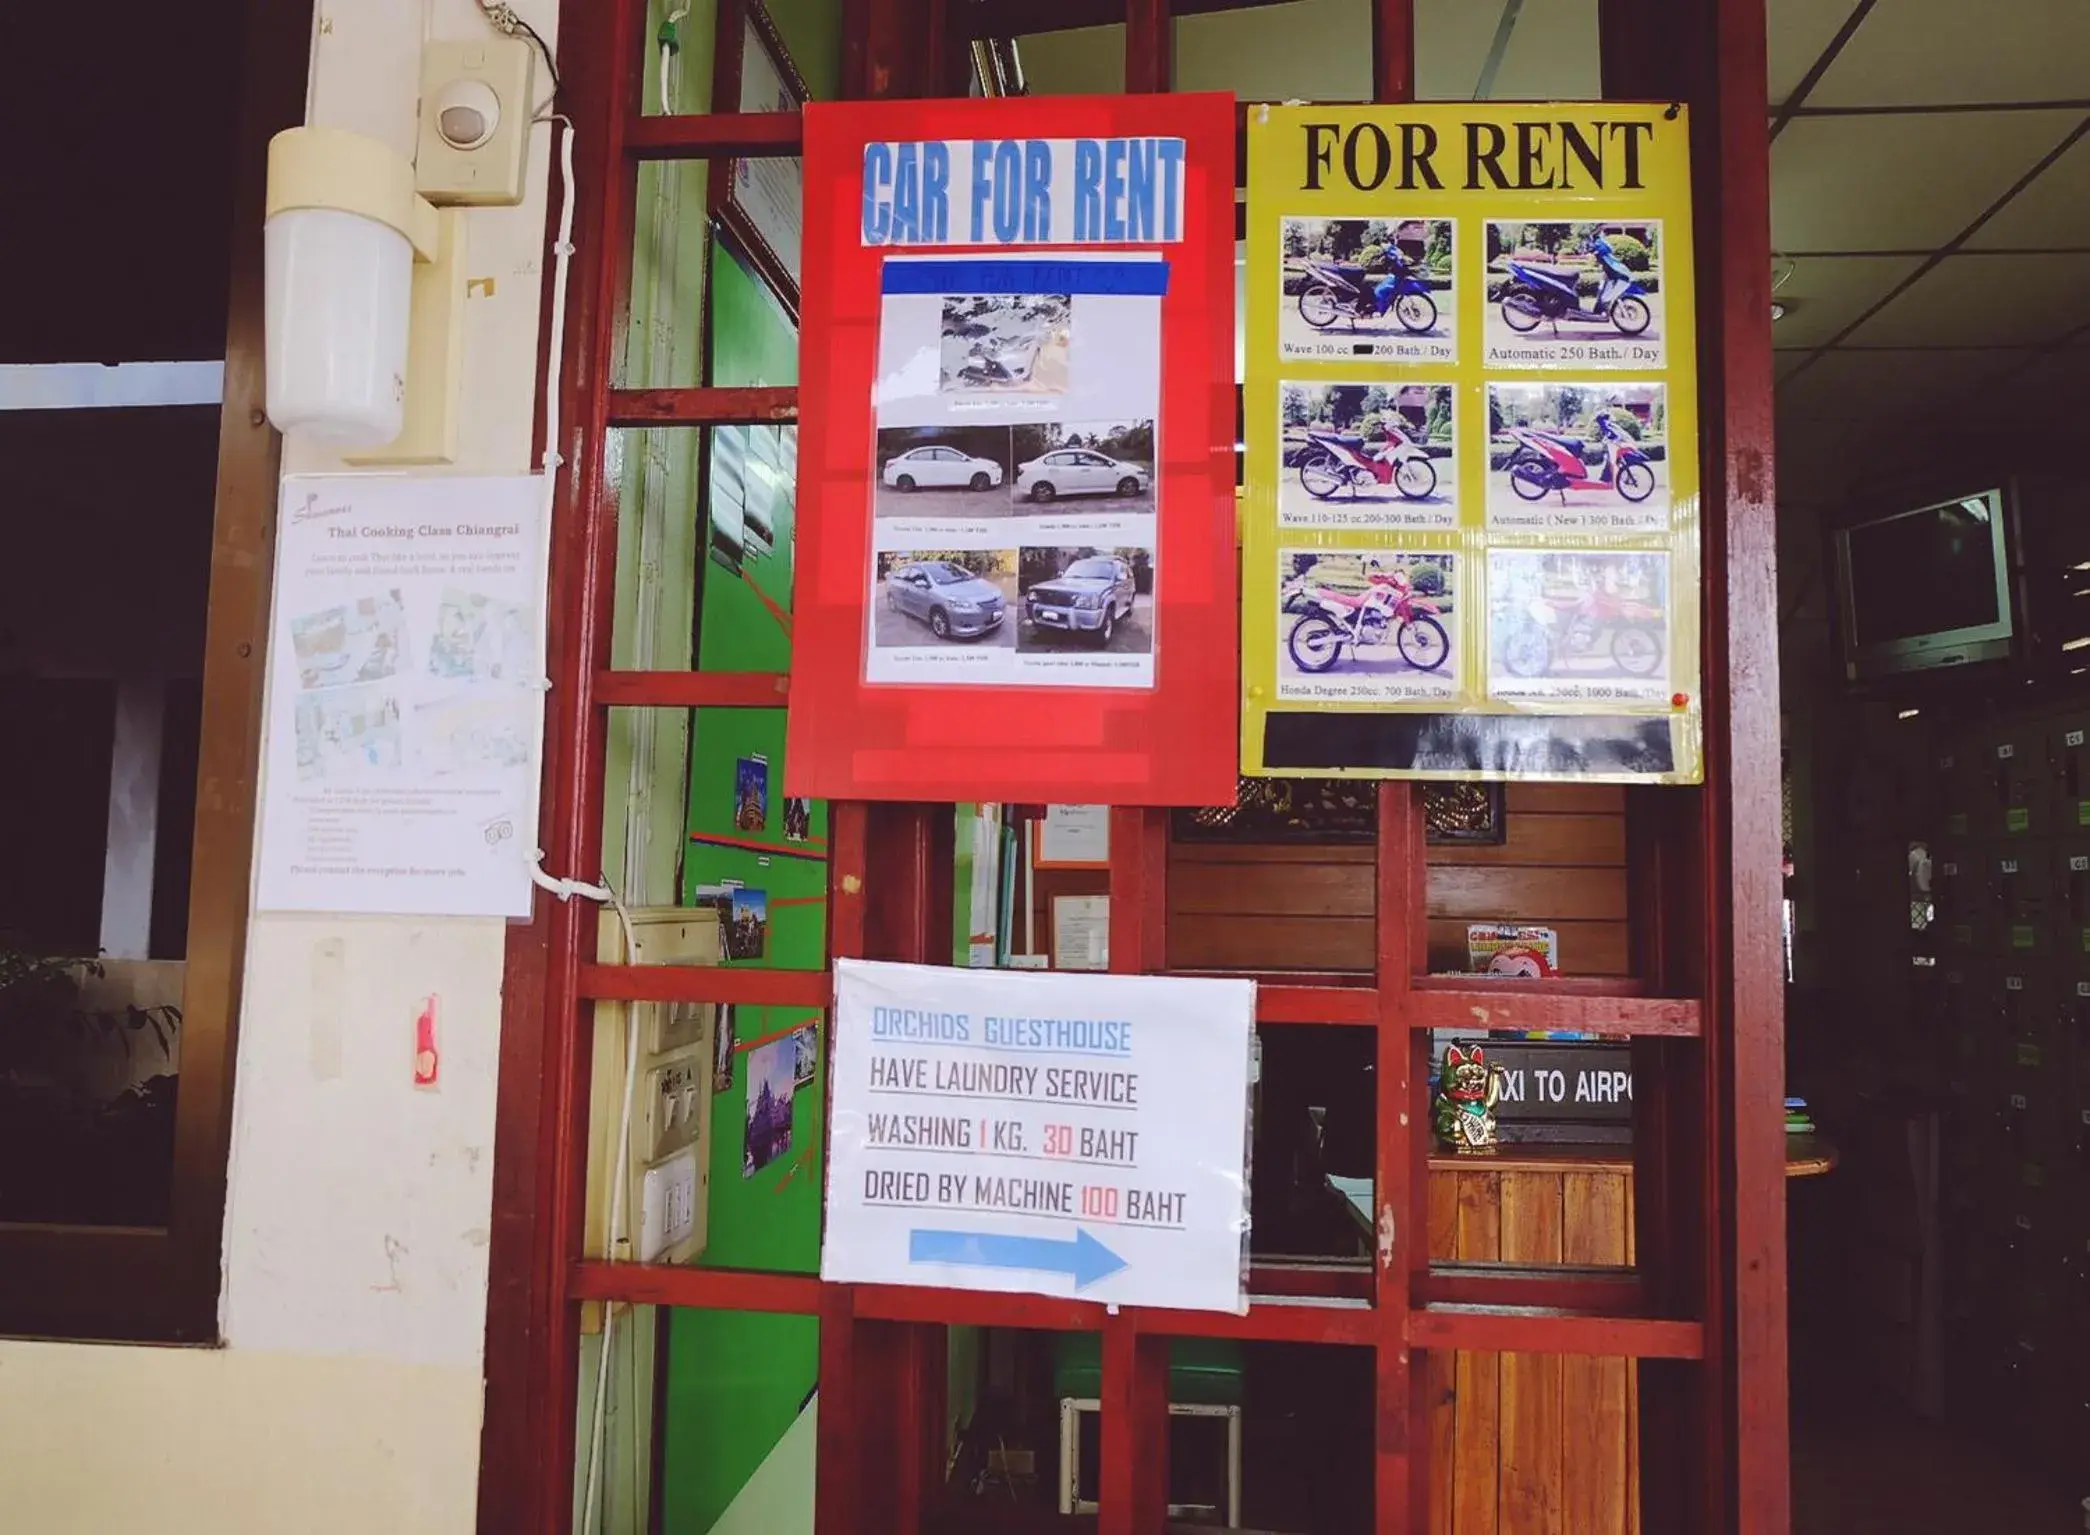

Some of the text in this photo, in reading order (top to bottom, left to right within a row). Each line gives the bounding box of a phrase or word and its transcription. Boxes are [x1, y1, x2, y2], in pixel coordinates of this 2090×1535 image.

[1301, 121, 1653, 191] FOR RENT
[863, 141, 949, 245] CAR
[970, 139, 1051, 244] FOR
[1073, 138, 1184, 241] RENT
[1284, 343, 1312, 354] Wave
[1316, 343, 1334, 354] 100
[1337, 345, 1348, 354] cc
[1374, 344, 1393, 355] 200
[1431, 345, 1451, 358] Day
[1489, 347, 1556, 359] Automatic
[1560, 347, 1584, 359] 250
[1633, 347, 1660, 362] Day
[328, 523, 519, 540] Thai Cooking Class Chiangrai
[1283, 513, 1308, 523] Wave
[1434, 514, 1453, 526] Day
[1491, 514, 1543, 525] Automatic
[1280, 684, 1311, 695] Honda
[1314, 684, 1348, 697] Degree
[872, 1006, 1131, 1051] ORCHIDS GUESTHOUSE
[870, 1056, 1138, 1103] HAVE LAUNDRY SERVICE
[1534, 1069, 1566, 1102] TO
[867, 1113, 1139, 1162] WASHING 1 KG. 30 BAHT
[864, 1170, 1187, 1224] DRIED BY MACHINE 100 BAHT
